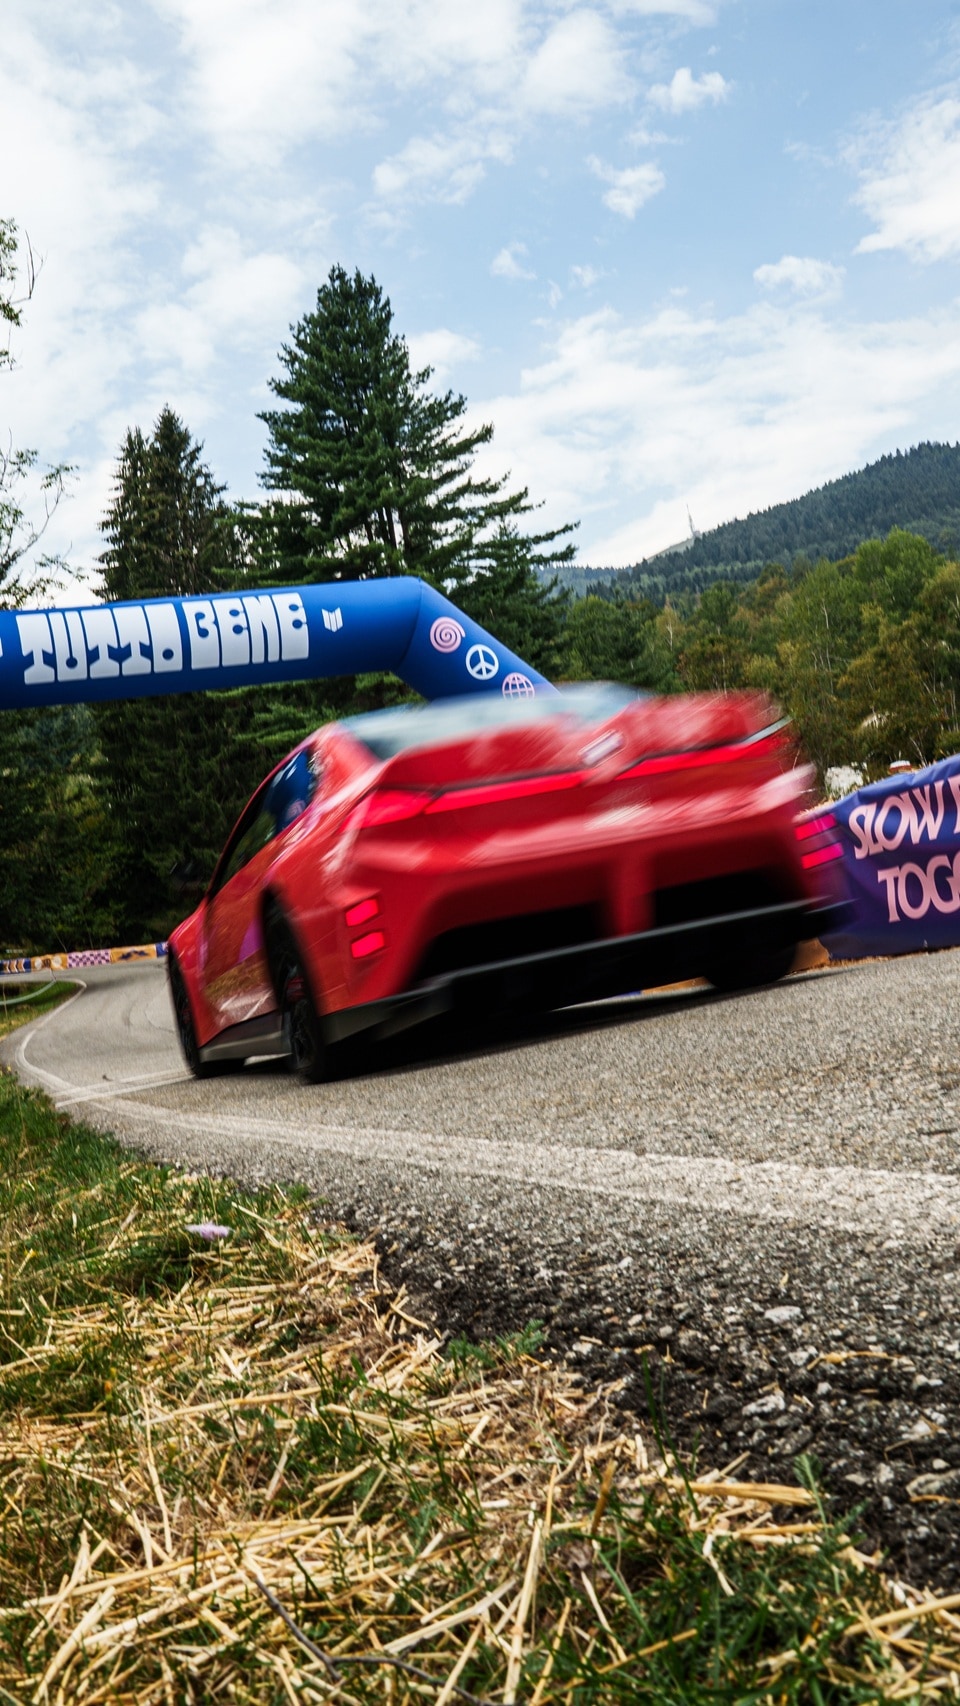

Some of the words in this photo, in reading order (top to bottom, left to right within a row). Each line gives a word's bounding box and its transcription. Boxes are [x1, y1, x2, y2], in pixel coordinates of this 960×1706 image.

[16, 603, 183, 684] TUTTO
[182, 592, 309, 670] BENE
[849, 780, 944, 859] SLOW
[877, 851, 960, 923] TOG
